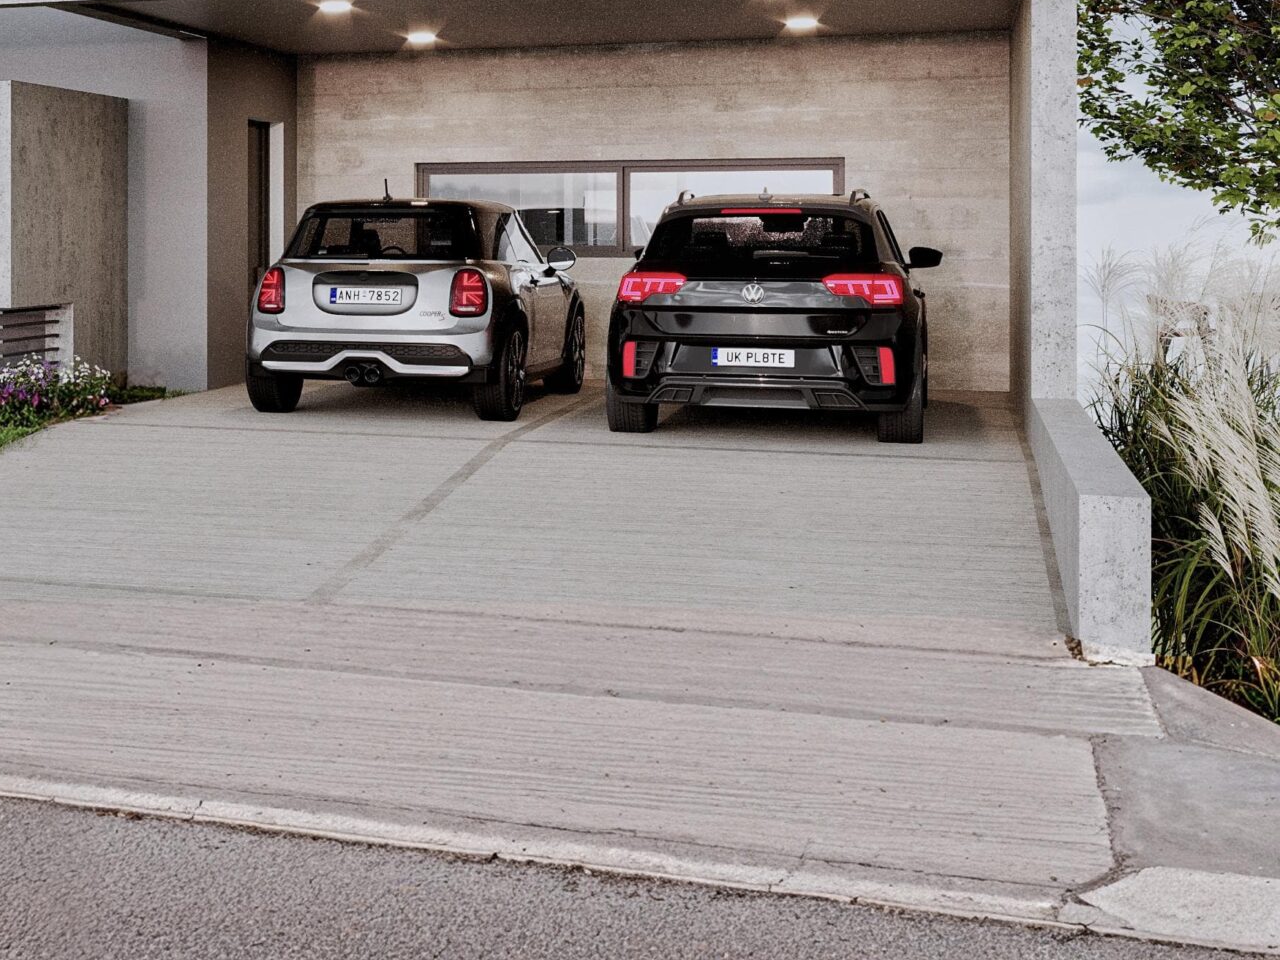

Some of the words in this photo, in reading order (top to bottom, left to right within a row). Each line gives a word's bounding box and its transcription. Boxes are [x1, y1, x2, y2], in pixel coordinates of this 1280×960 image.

[338, 290, 399, 301] ANH-7852
[726, 352, 741, 362] UK
[746, 352, 785, 364] PL8TE
